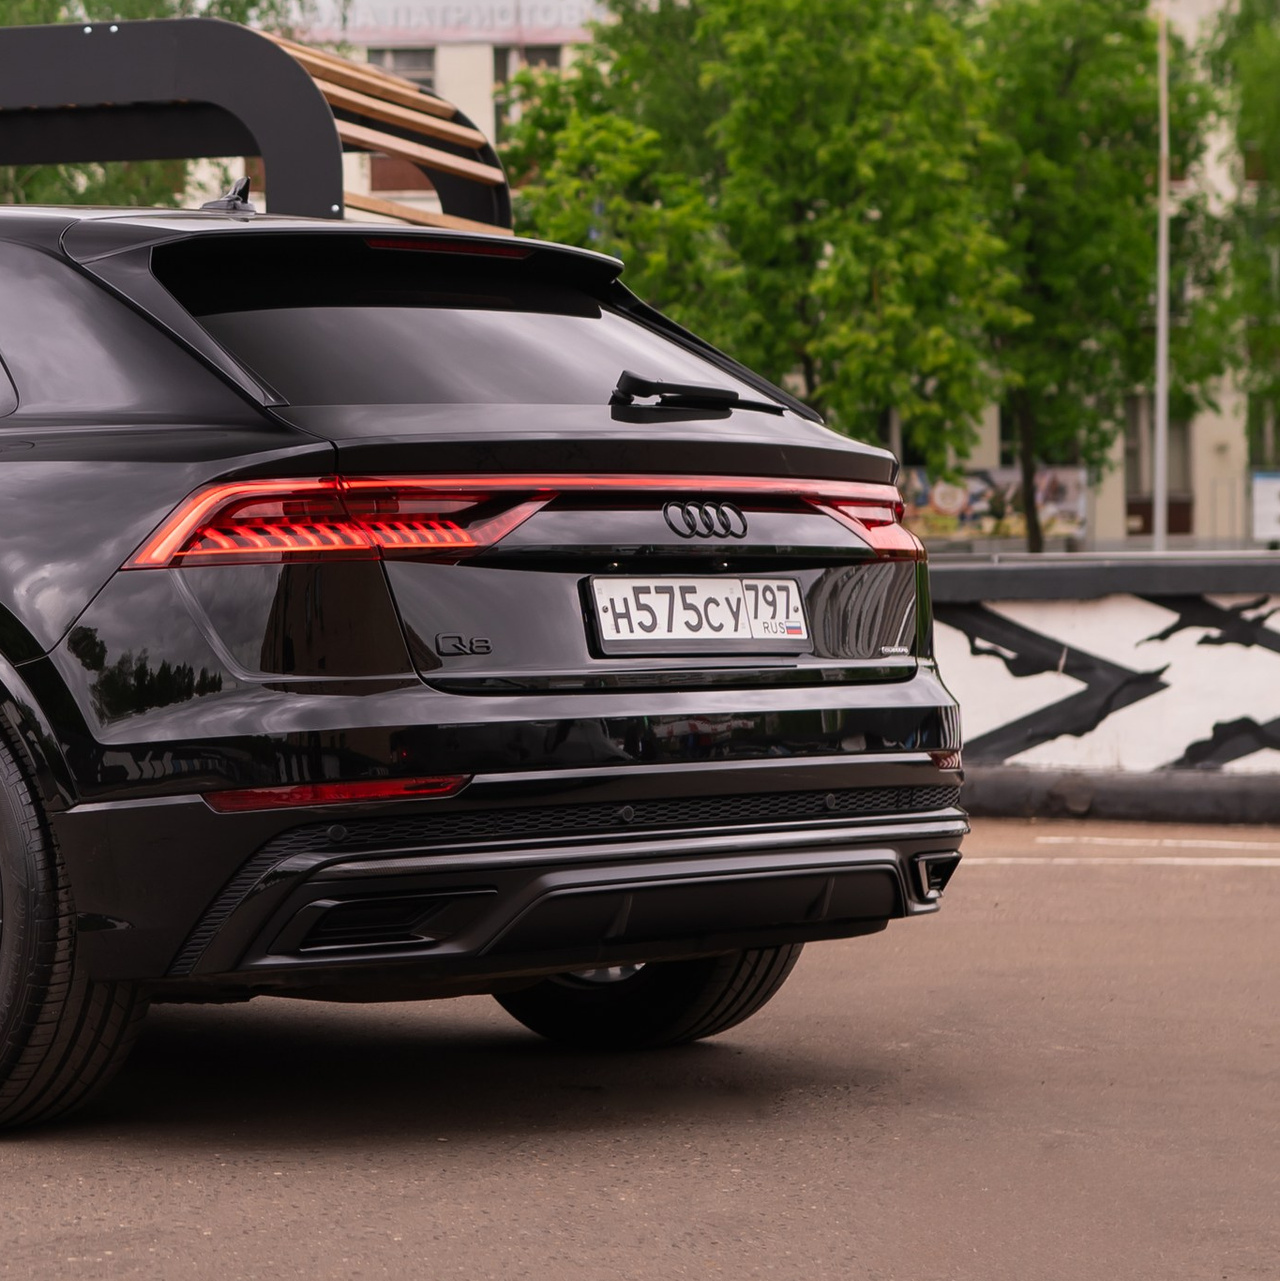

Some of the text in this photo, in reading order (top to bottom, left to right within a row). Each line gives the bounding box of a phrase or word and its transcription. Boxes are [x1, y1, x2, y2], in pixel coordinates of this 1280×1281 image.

[745, 584, 790, 620] 797
[763, 621, 786, 634] RUS
[435, 632, 493, 656] Q8
